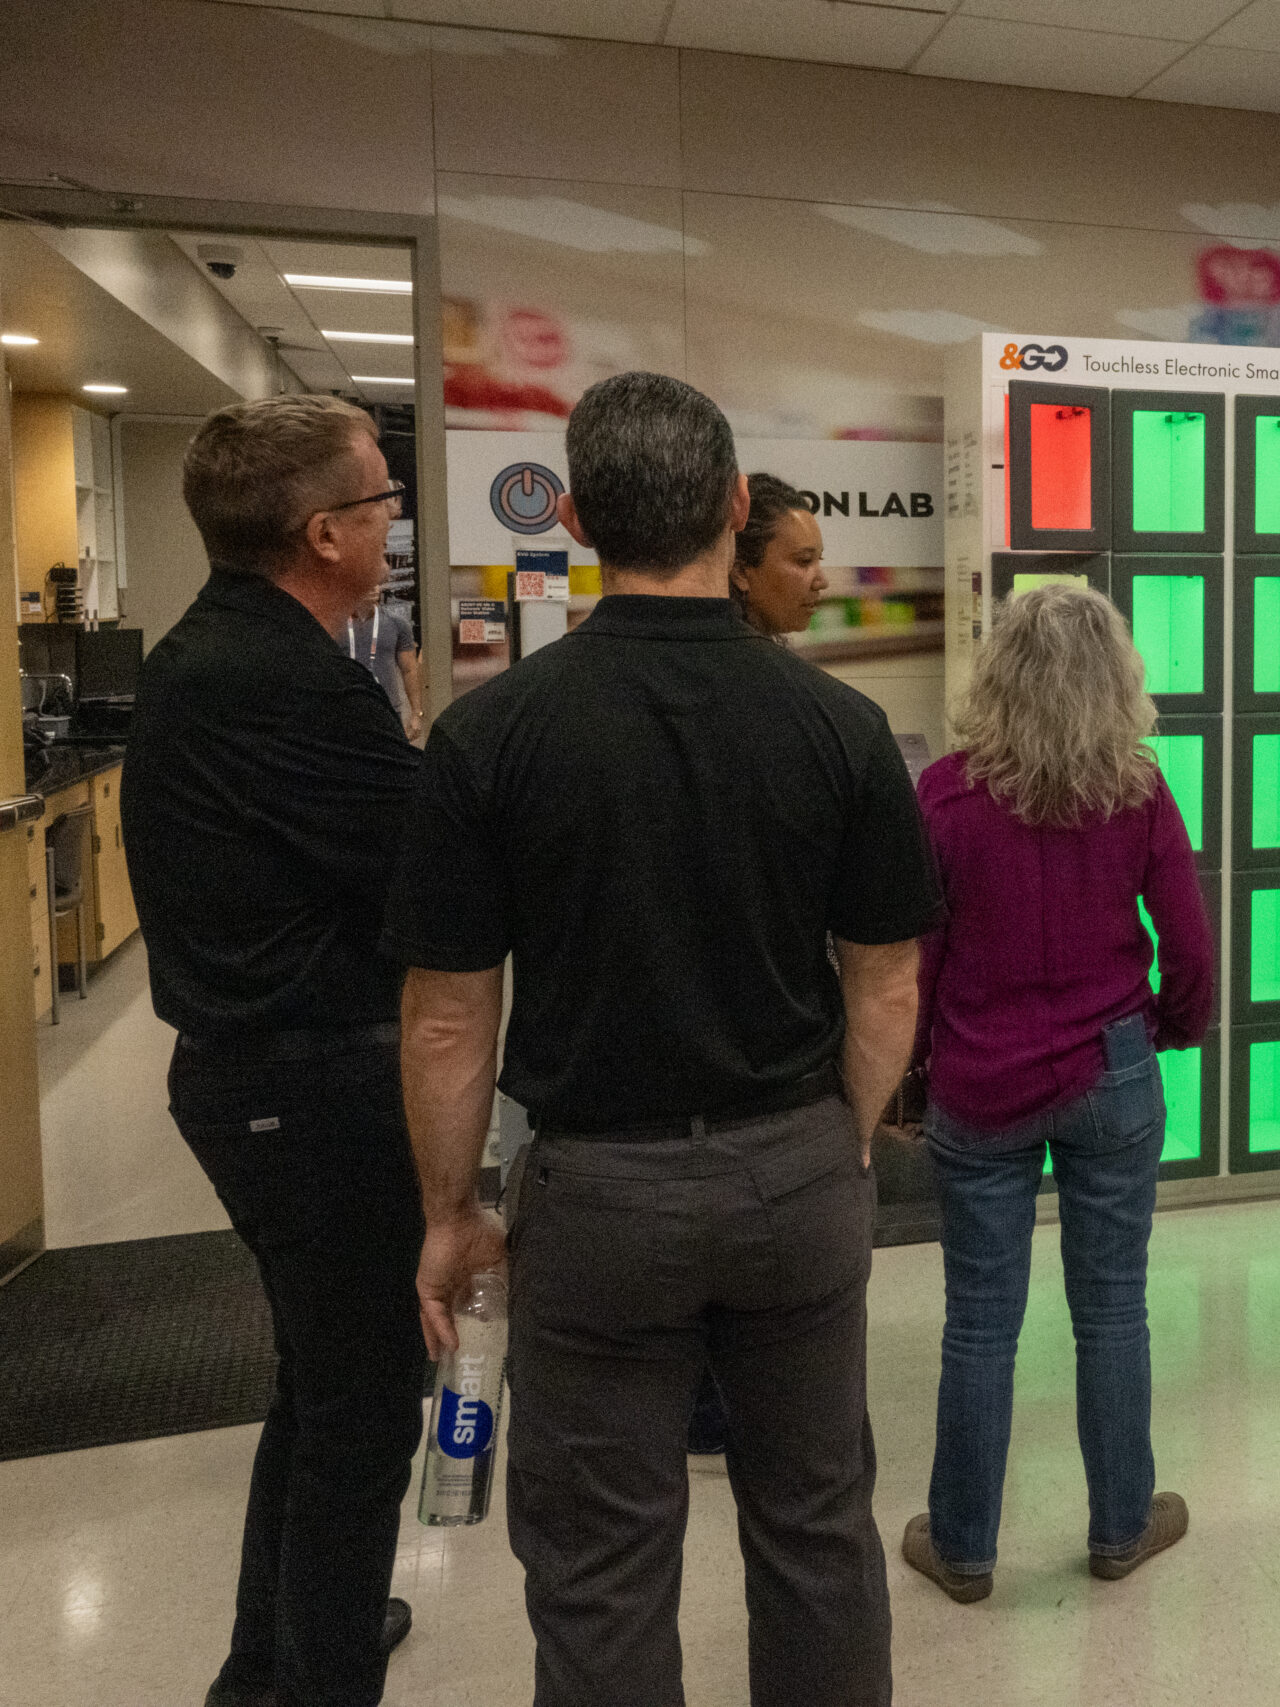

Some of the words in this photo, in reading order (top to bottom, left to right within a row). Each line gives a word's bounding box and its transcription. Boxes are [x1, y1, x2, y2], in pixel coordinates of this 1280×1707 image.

[1082, 355, 1160, 375] Touchless
[1165, 359, 1241, 378] Electronic
[858, 491, 935, 518] LAB
[453, 1354, 485, 1445] smart
